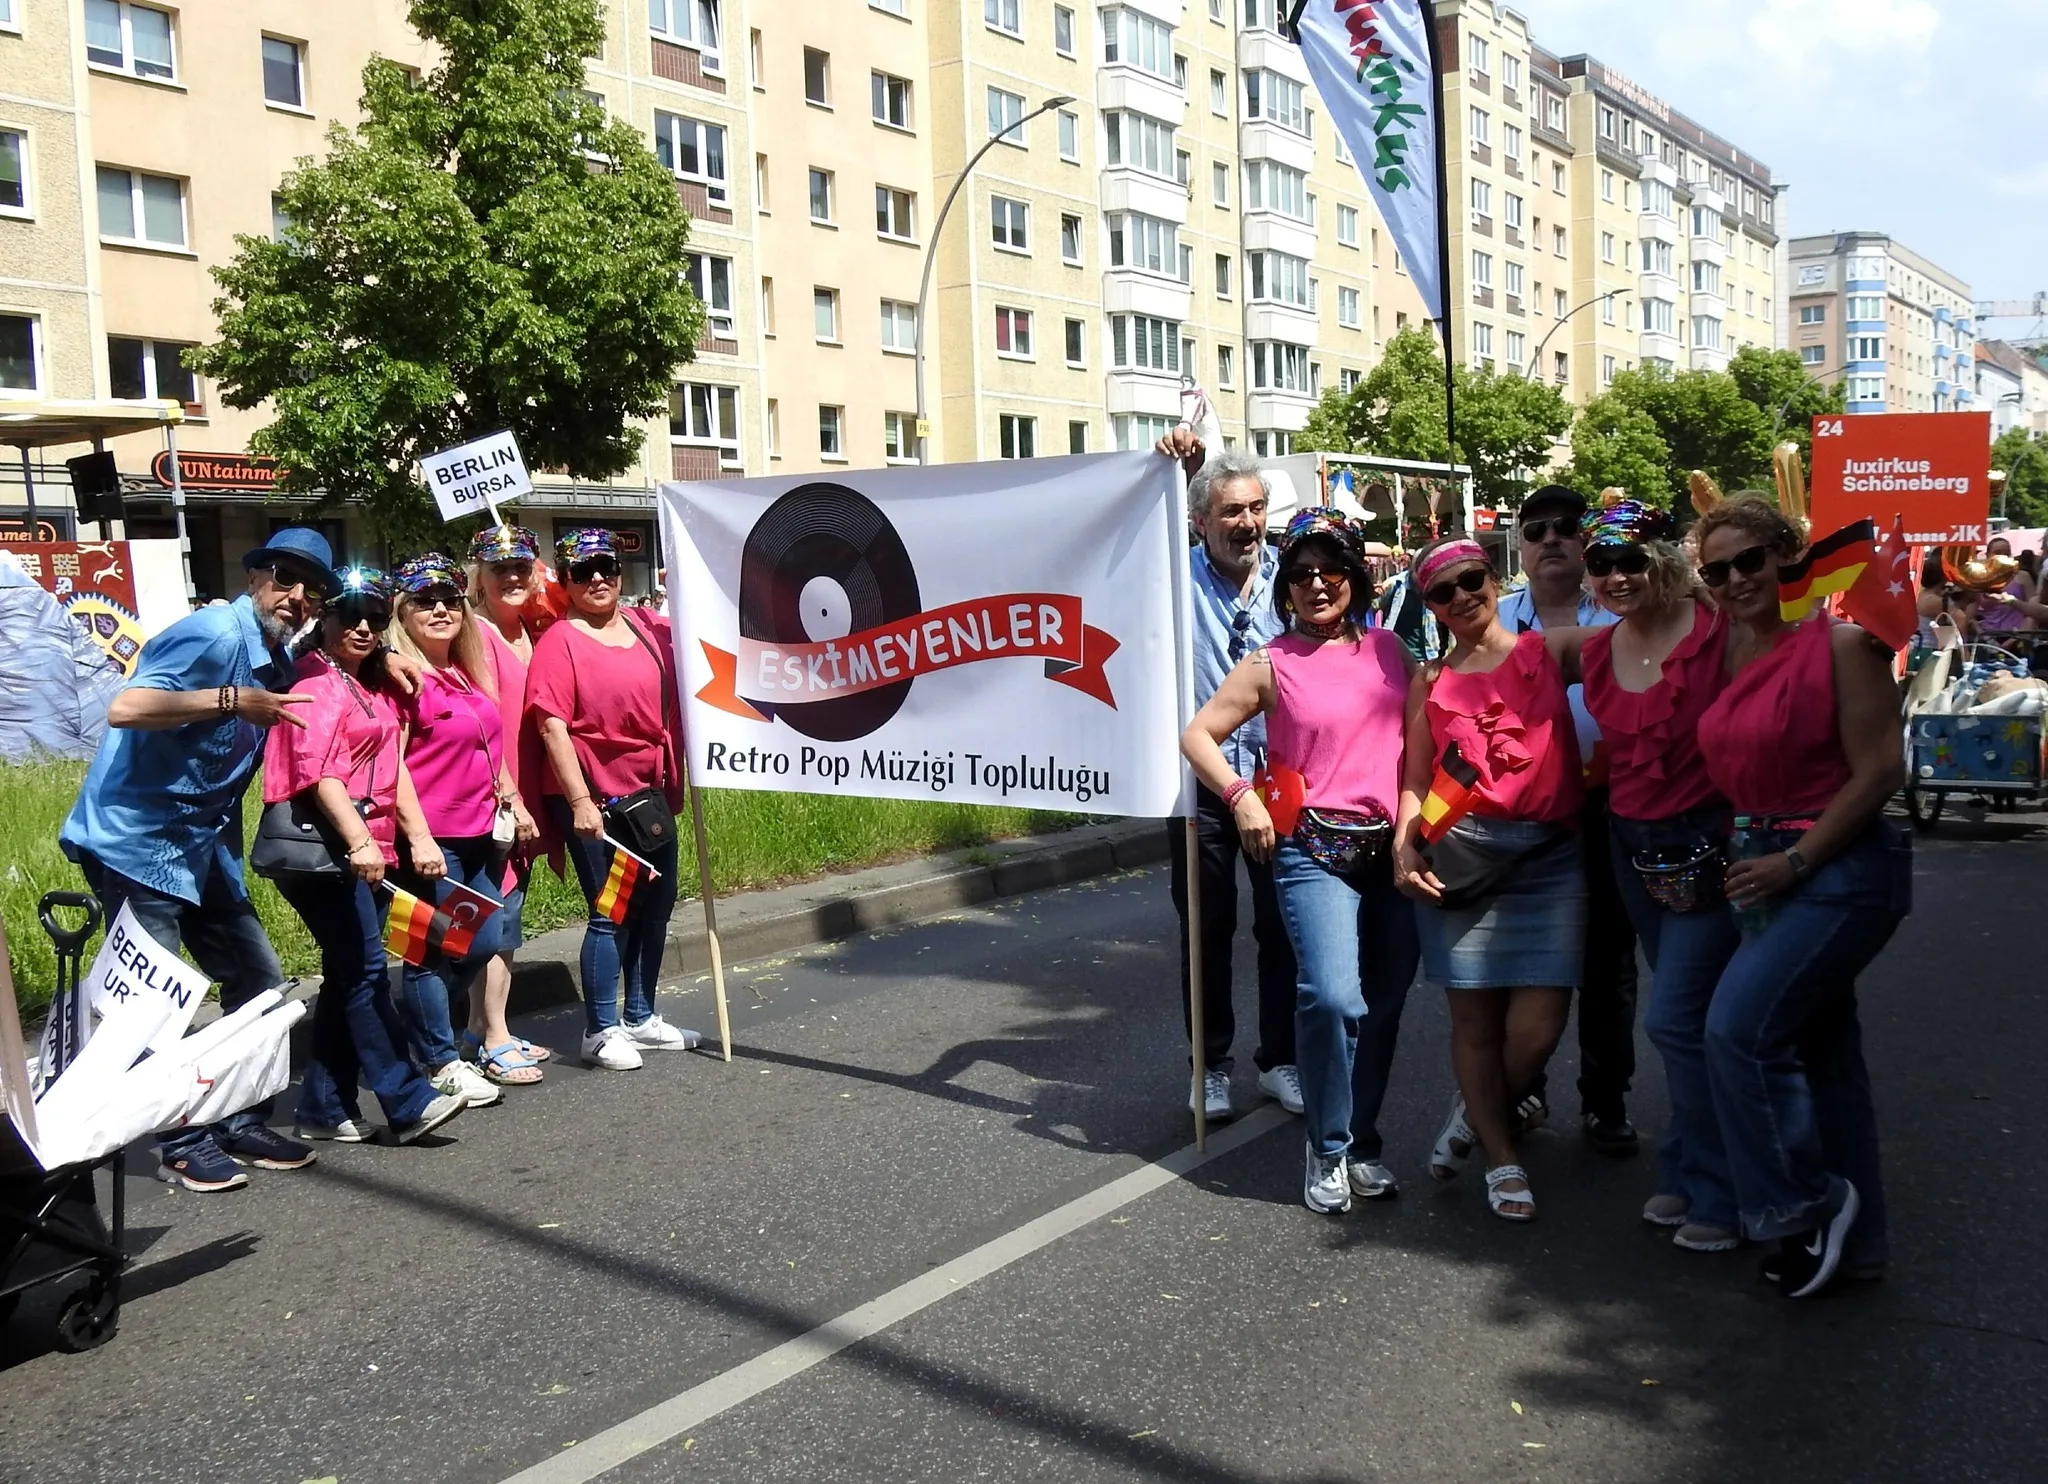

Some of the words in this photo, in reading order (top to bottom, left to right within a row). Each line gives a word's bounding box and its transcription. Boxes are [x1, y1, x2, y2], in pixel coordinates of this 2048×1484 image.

[1817, 420, 1843, 437] 24
[435, 446, 515, 485] BERLIN
[1842, 457, 1931, 475] Juxirkus
[452, 473, 516, 504] BURSA
[1842, 475, 1969, 494] Schöneberg
[757, 602, 1064, 692] ESKİMEYENLER
[706, 742, 790, 775] Retro
[800, 746, 850, 785] Pop
[860, 749, 955, 792] Müziği
[965, 753, 1110, 802] Topluluğu
[112, 925, 192, 1009] BERLIN
